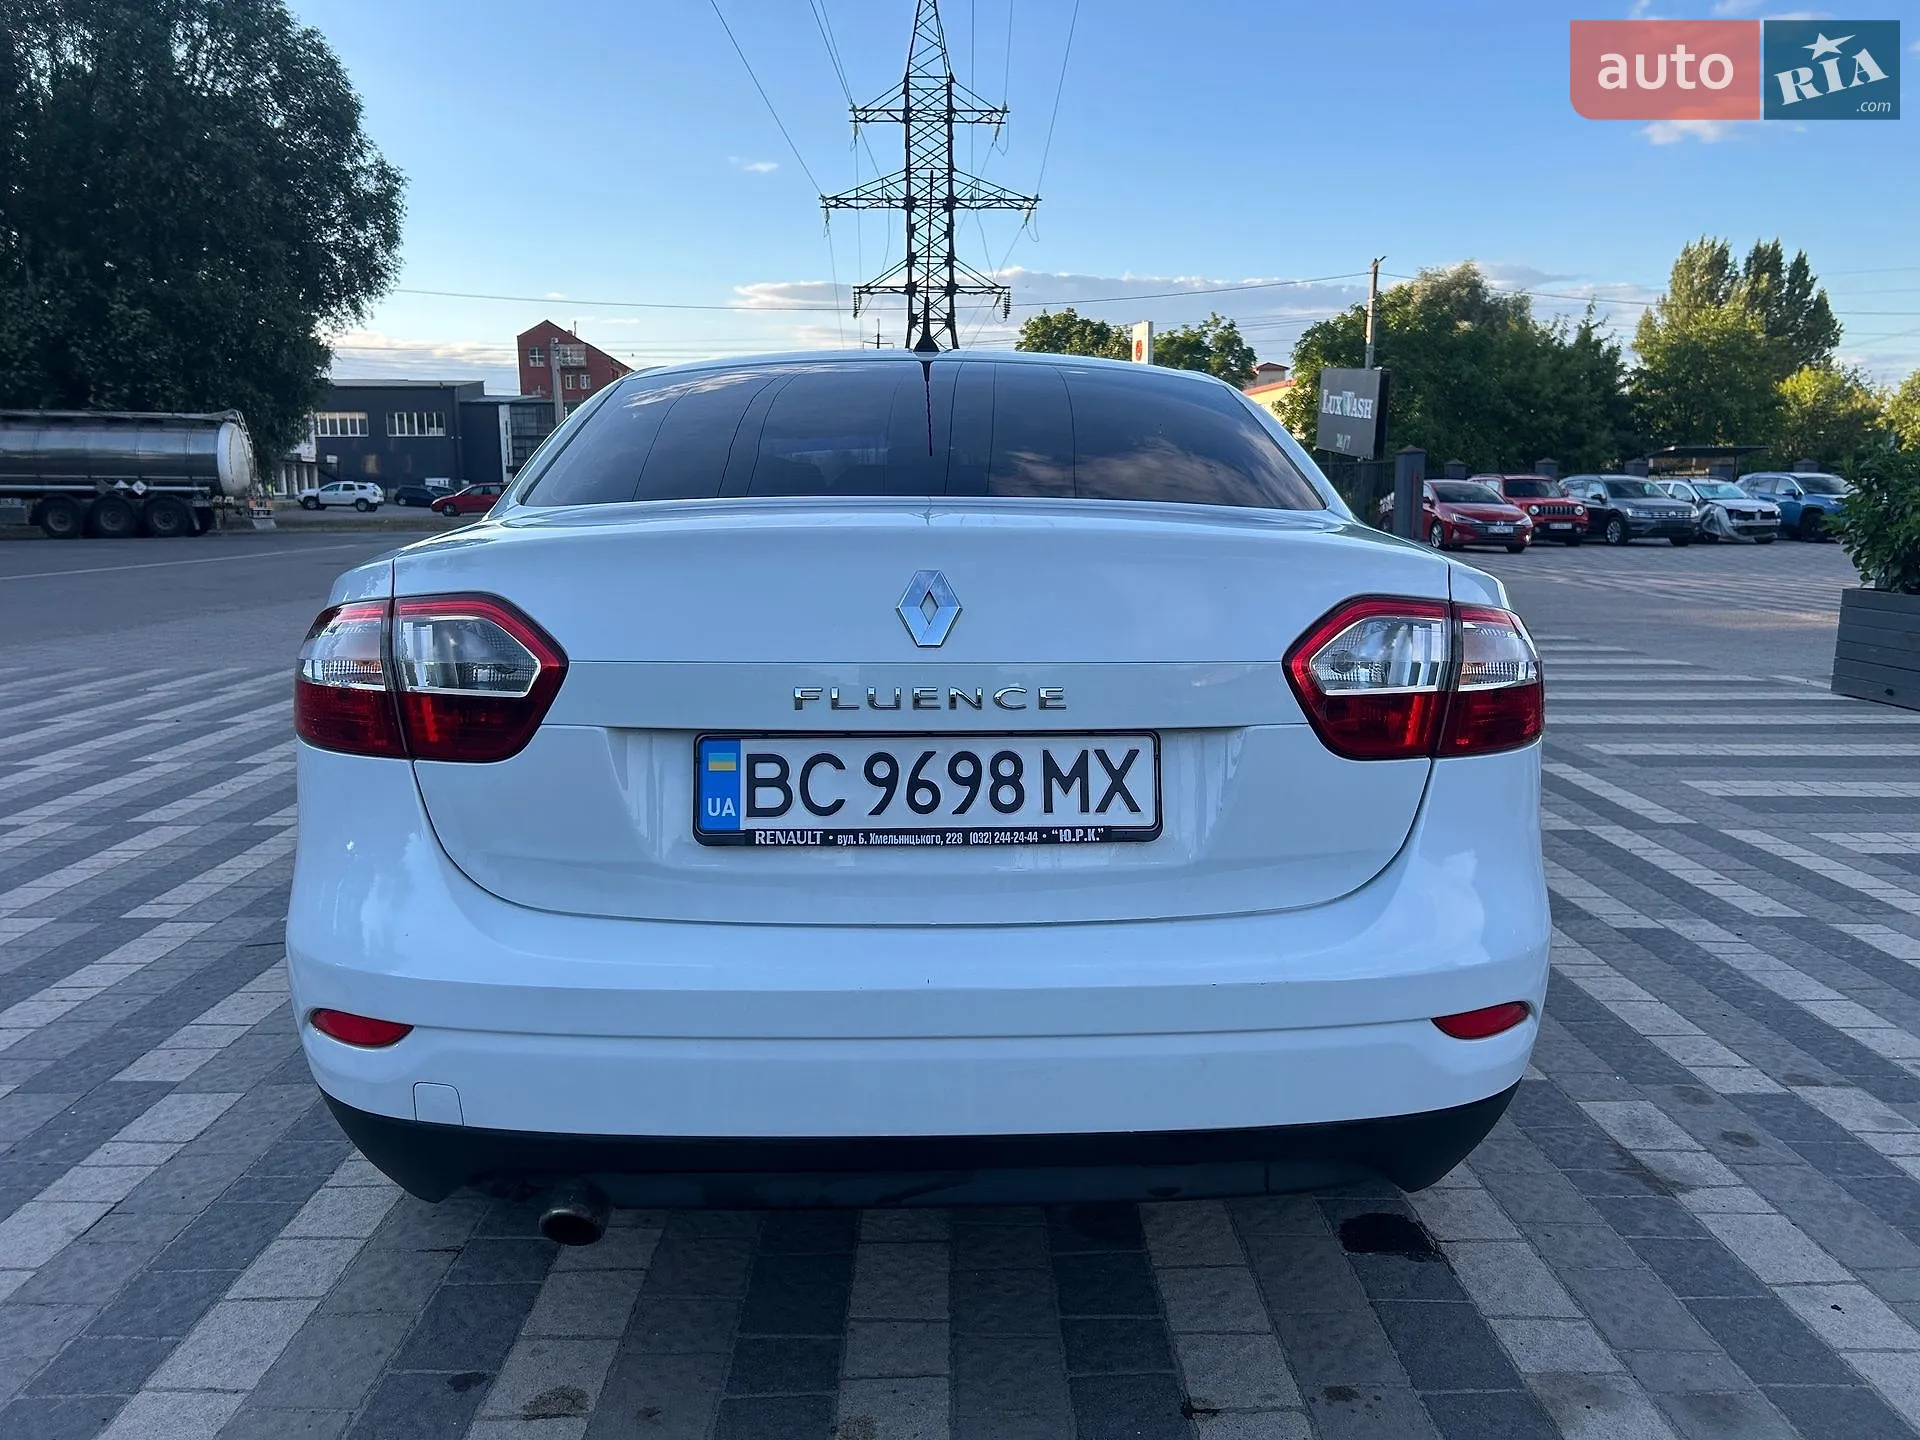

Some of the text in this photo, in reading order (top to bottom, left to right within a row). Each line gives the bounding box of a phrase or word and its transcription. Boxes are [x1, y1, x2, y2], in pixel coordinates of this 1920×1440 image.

[792, 686, 1068, 711] FLUENCE
[746, 748, 1142, 818] BC 9698 MX
[707, 797, 736, 817] UA
[754, 830, 824, 845] RENAULT
[837, 833, 857, 846] вул.
[858, 833, 867, 845] Б.
[945, 832, 963, 845] 228
[969, 831, 992, 845] (032)
[994, 831, 1039, 844] 244-24-44
